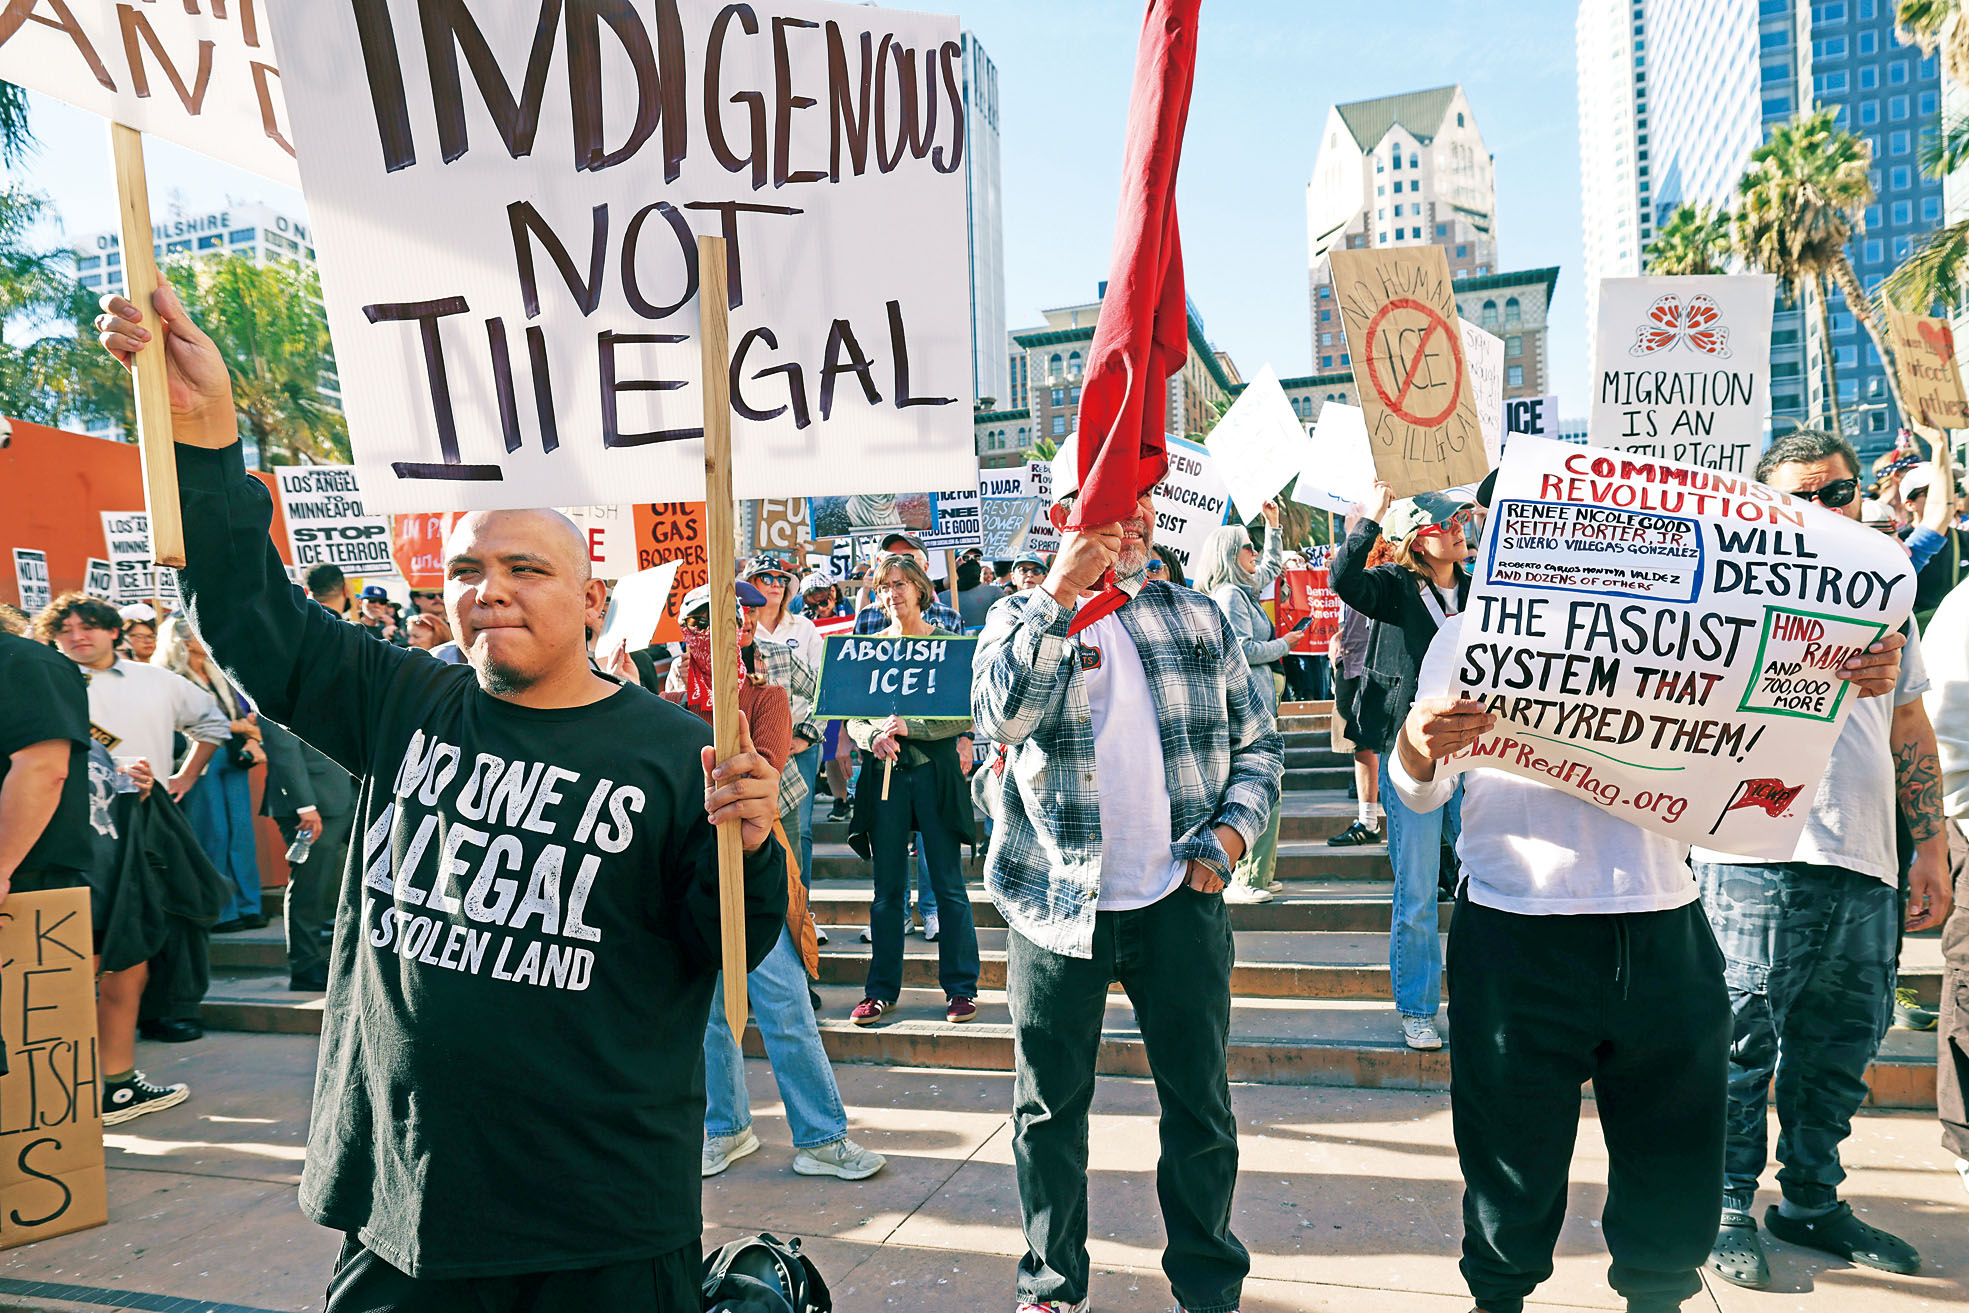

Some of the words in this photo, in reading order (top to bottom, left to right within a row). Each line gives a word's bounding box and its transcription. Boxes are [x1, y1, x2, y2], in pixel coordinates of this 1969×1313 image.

[355, 0, 962, 191] INDIGENOUS
[276, 215, 314, 245] ON
[506, 200, 804, 320] NOT
[1342, 280, 1379, 331] NO
[1376, 261, 1457, 320] HUMAN
[1382, 327, 1448, 394] ICE
[1602, 370, 1754, 406] MIGRATION
[1375, 409, 1396, 447] IS
[1506, 399, 1545, 434] ICE
[1622, 410, 1658, 437] IS
[1671, 410, 1715, 436] AN
[1168, 452, 1203, 477] FEND
[283, 475, 312, 493] LOS
[991, 479, 1023, 496] WAR,
[1153, 481, 1224, 515] EMOCRACY
[762, 498, 810, 524] FU
[982, 500, 1021, 515] REST
[1540, 473, 1806, 528] REVOLUTION
[651, 518, 698, 544] GAS
[952, 519, 980, 535] GOOD
[1155, 511, 1188, 534] SIST
[1507, 503, 1571, 521] RENEE
[1575, 508, 1635, 527] NICOLE
[1637, 515, 1692, 534] GOOD
[293, 525, 386, 542] STOP
[759, 520, 817, 551] ICE
[1502, 536, 1559, 550] SILVERIO
[1564, 539, 1625, 553] VILLEGAS
[1627, 543, 1699, 558] GONZALEZ
[1505, 519, 1567, 537] KEITH
[1571, 521, 1653, 547] PORTER,
[1656, 531, 1688, 548] JR.
[1713, 523, 1818, 559] WILL
[297, 545, 325, 563] ICE
[326, 541, 390, 563] TERROR
[640, 545, 708, 570] BORDER
[670, 569, 708, 590] SCIS
[1495, 569, 1522, 582] AND
[1525, 571, 1577, 586] DOZENS
[1580, 576, 1600, 587] OF
[1602, 578, 1654, 591] OTHERS
[1498, 561, 1542, 570] ROBERTO
[1544, 563, 1582, 574] CARLOS
[1582, 567, 1626, 578] MONTOYA
[1630, 569, 1681, 585] VALDEZ
[1713, 559, 1907, 612] DESTROY
[1476, 595, 1550, 638] THE
[1564, 601, 1757, 668] FASCIST
[1772, 612, 1825, 642] HIND
[837, 638, 947, 662] ABOLISH
[868, 667, 936, 696] ICE!
[1459, 643, 1621, 698] SYSTEM
[1634, 666, 1726, 707] THAT
[1764, 660, 1802, 677] AND
[1761, 677, 1831, 696] 700,000
[1773, 696, 1826, 713] MORE
[1649, 709, 1767, 763] THEM!
[392, 728, 461, 807] NO
[455, 752, 581, 834] ONE
[572, 778, 646, 854] IS
[1443, 735, 1689, 824] WPRedFlag.org
[1750, 783, 1790, 805] ICWP
[364, 802, 602, 943] ILLEGAL
[369, 905, 492, 975] STOLEN
[491, 936, 595, 991] LAND
